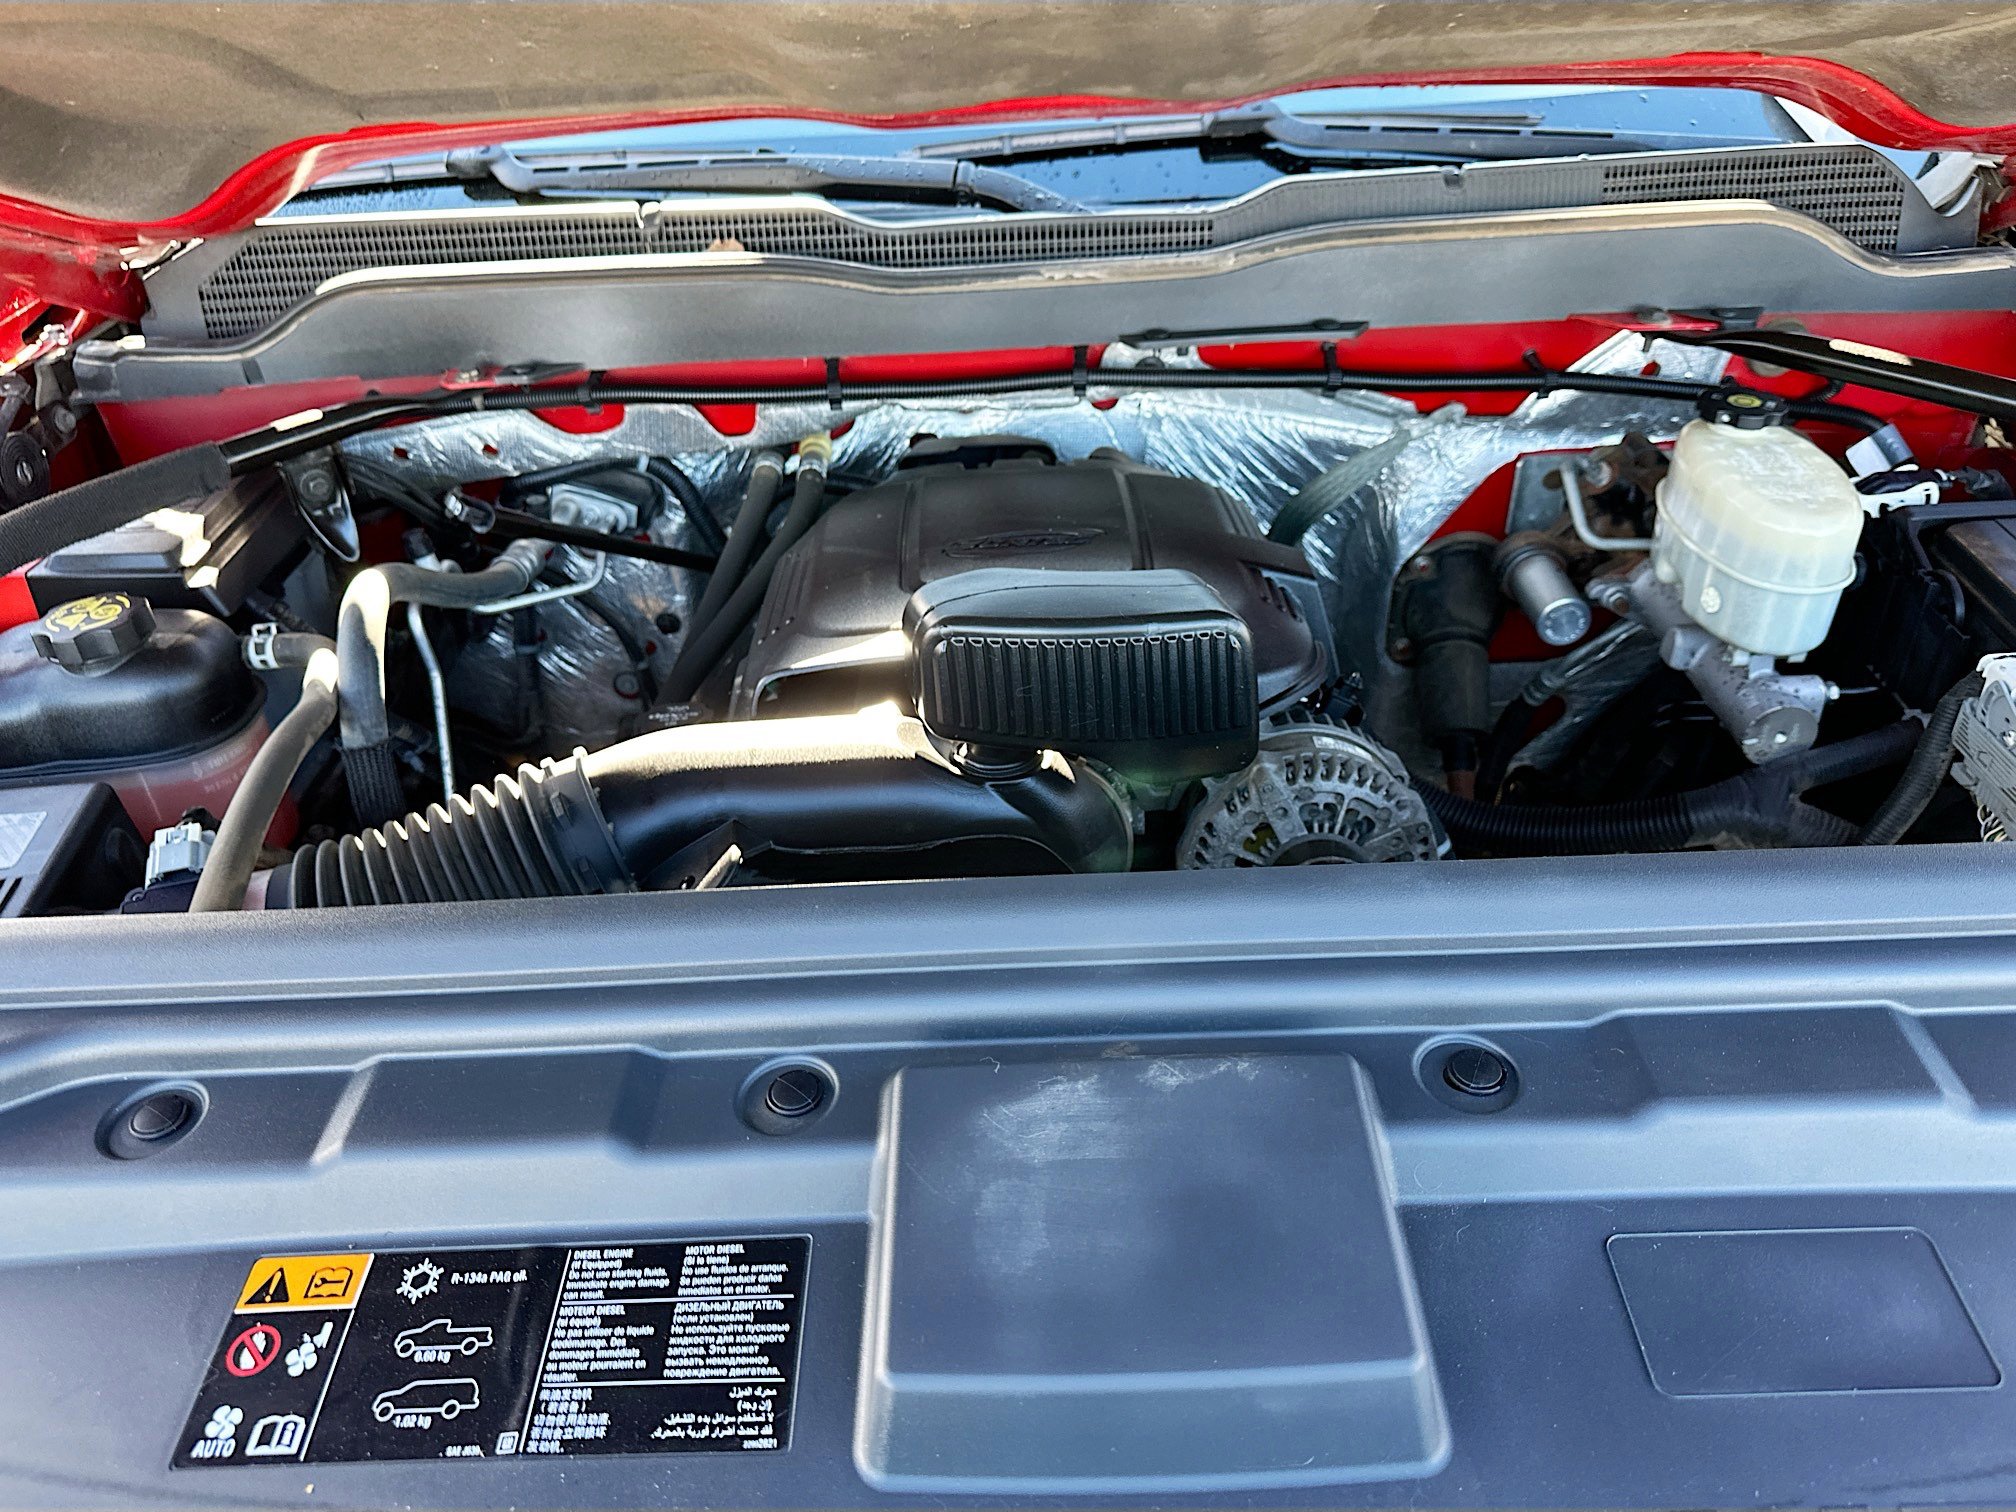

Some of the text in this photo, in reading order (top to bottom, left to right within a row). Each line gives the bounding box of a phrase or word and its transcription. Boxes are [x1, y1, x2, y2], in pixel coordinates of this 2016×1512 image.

[574, 1249, 634, 1259] DIESEL ENGINE
[685, 1244, 745, 1255] MOTOR DIESEL
[706, 1255, 729, 1265] tiene)
[569, 1270, 580, 1279] Do
[581, 1270, 594, 1279] not
[612, 1269, 642, 1278] starting
[644, 1267, 667, 1277] fluids.
[682, 1264, 788, 1275] No use fluidos de arranque.
[451, 1272, 488, 1284] R-134a
[490, 1271, 511, 1283] PAG
[680, 1274, 782, 1286] Se pueden producir daños
[566, 1278, 670, 1290] Immediate engine damage
[563, 1290, 604, 1300] can result.
[678, 1285, 770, 1296] inmediatos en el motor.
[560, 1305, 625, 1316] MOTEUR DIESEL
[674, 1300, 784, 1313] ДИЗЕЛЬНЫЙ ДВИГАТЕЛЬ
[673, 1312, 754, 1324] (если установлен)
[554, 1325, 654, 1338] Ne pas utiliser de liquide
[671, 1324, 790, 1334] Не используйте пусковые
[610, 1337, 626, 1347] Des
[669, 1334, 785, 1345] жидкости для холодного
[548, 1348, 640, 1360] dommages immédiats
[708, 1345, 726, 1354] Это
[729, 1345, 759, 1354] может
[438, 1350, 451, 1363] kg
[665, 1356, 769, 1366] вызвать немедленное
[546, 1360, 646, 1371] au moteur pourraient en
[663, 1368, 727, 1378] повреждение
[417, 1414, 431, 1429] kg
[192, 1440, 236, 1459] AUTO
